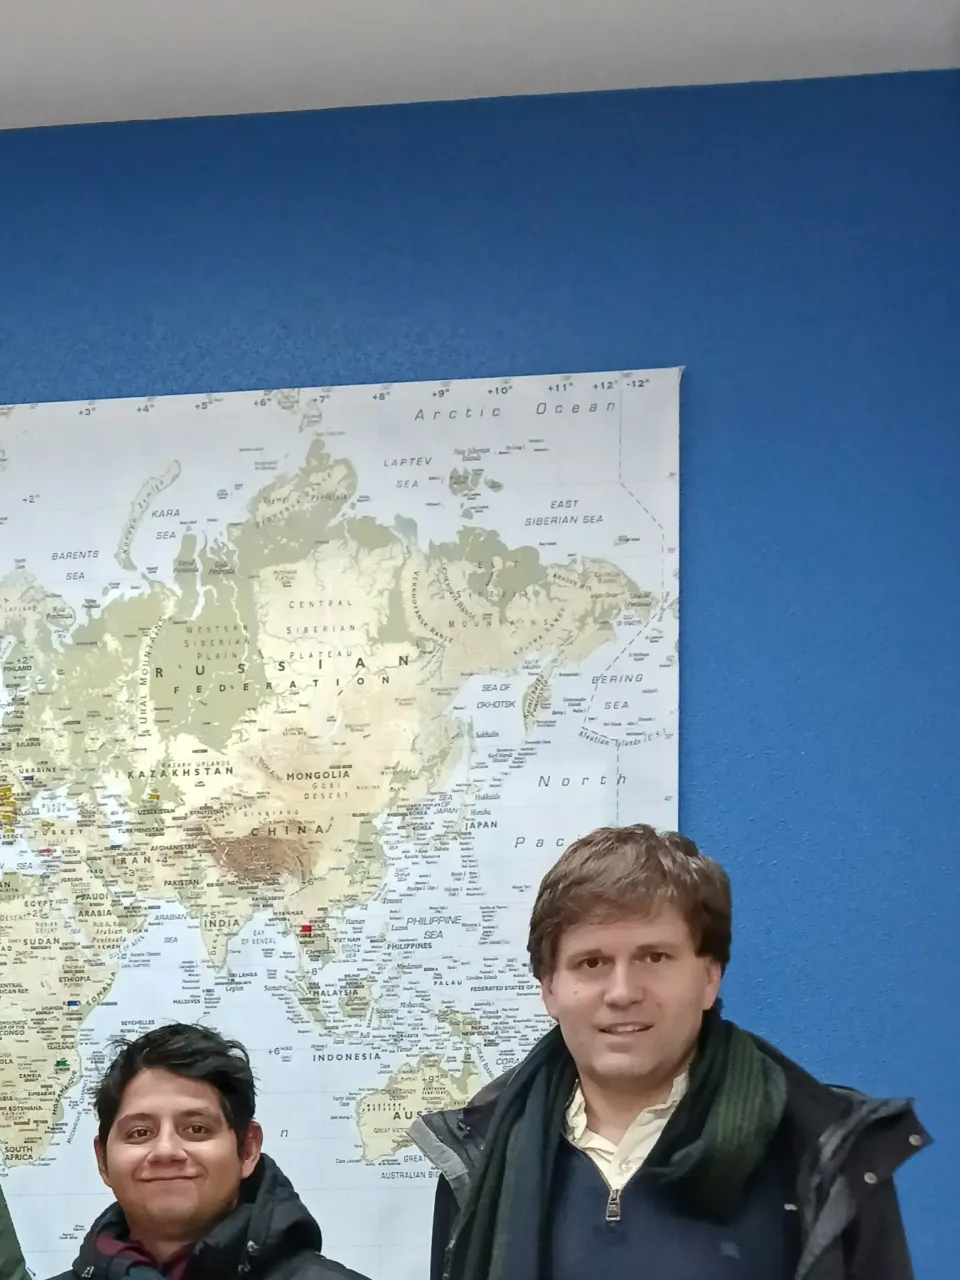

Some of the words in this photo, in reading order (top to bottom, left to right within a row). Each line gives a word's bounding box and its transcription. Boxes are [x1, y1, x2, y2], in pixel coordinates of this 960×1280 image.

[414, 407, 501, 421] Arctic
[536, 401, 616, 415] Ocean
[383, 456, 433, 467] LAPTEV
[396, 480, 419, 489] SEA
[550, 500, 579, 510] EAST
[151, 508, 180, 518] KARA
[524, 515, 579, 526] SIBERIAN
[582, 515, 604, 525] SEA
[156, 531, 176, 540] SEA
[51, 550, 100, 561] BARENTS
[66, 572, 85, 581] SEA
[289, 600, 352, 609] CENTRAL
[286, 624, 356, 635] SIBERIAN
[197, 652, 237, 660] PLAIN
[290, 651, 352, 660] PLATEAU
[155, 655, 409, 679] RUSSIAN
[591, 673, 643, 685] BERING
[173, 675, 390, 695] FEDERATION
[481, 684, 495, 692] SEA
[496, 683, 511, 691] OF
[476, 700, 516, 709] OKHOTSK
[604, 701, 629, 710] SEA
[127, 766, 234, 780] KAZAKHSTAN
[286, 770, 350, 781] MONGOLIA
[538, 774, 627, 787] North
[465, 820, 498, 831] JAPAN
[251, 824, 324, 837] CHINA
[113, 857, 151, 865] IRAN
[163, 878, 200, 887] PAKISTAN
[24, 900, 53, 908] EGYPT
[78, 909, 112, 918] ARABIA
[154, 913, 187, 921] ARABIAN
[203, 919, 240, 928] INDIA
[406, 915, 462, 926] PHILIPPINE
[424, 931, 444, 940] SEA
[313, 989, 358, 997] MALAYSIA
[312, 1052, 381, 1062] INDONESIA
[404, 1155, 427, 1163] GREAT
